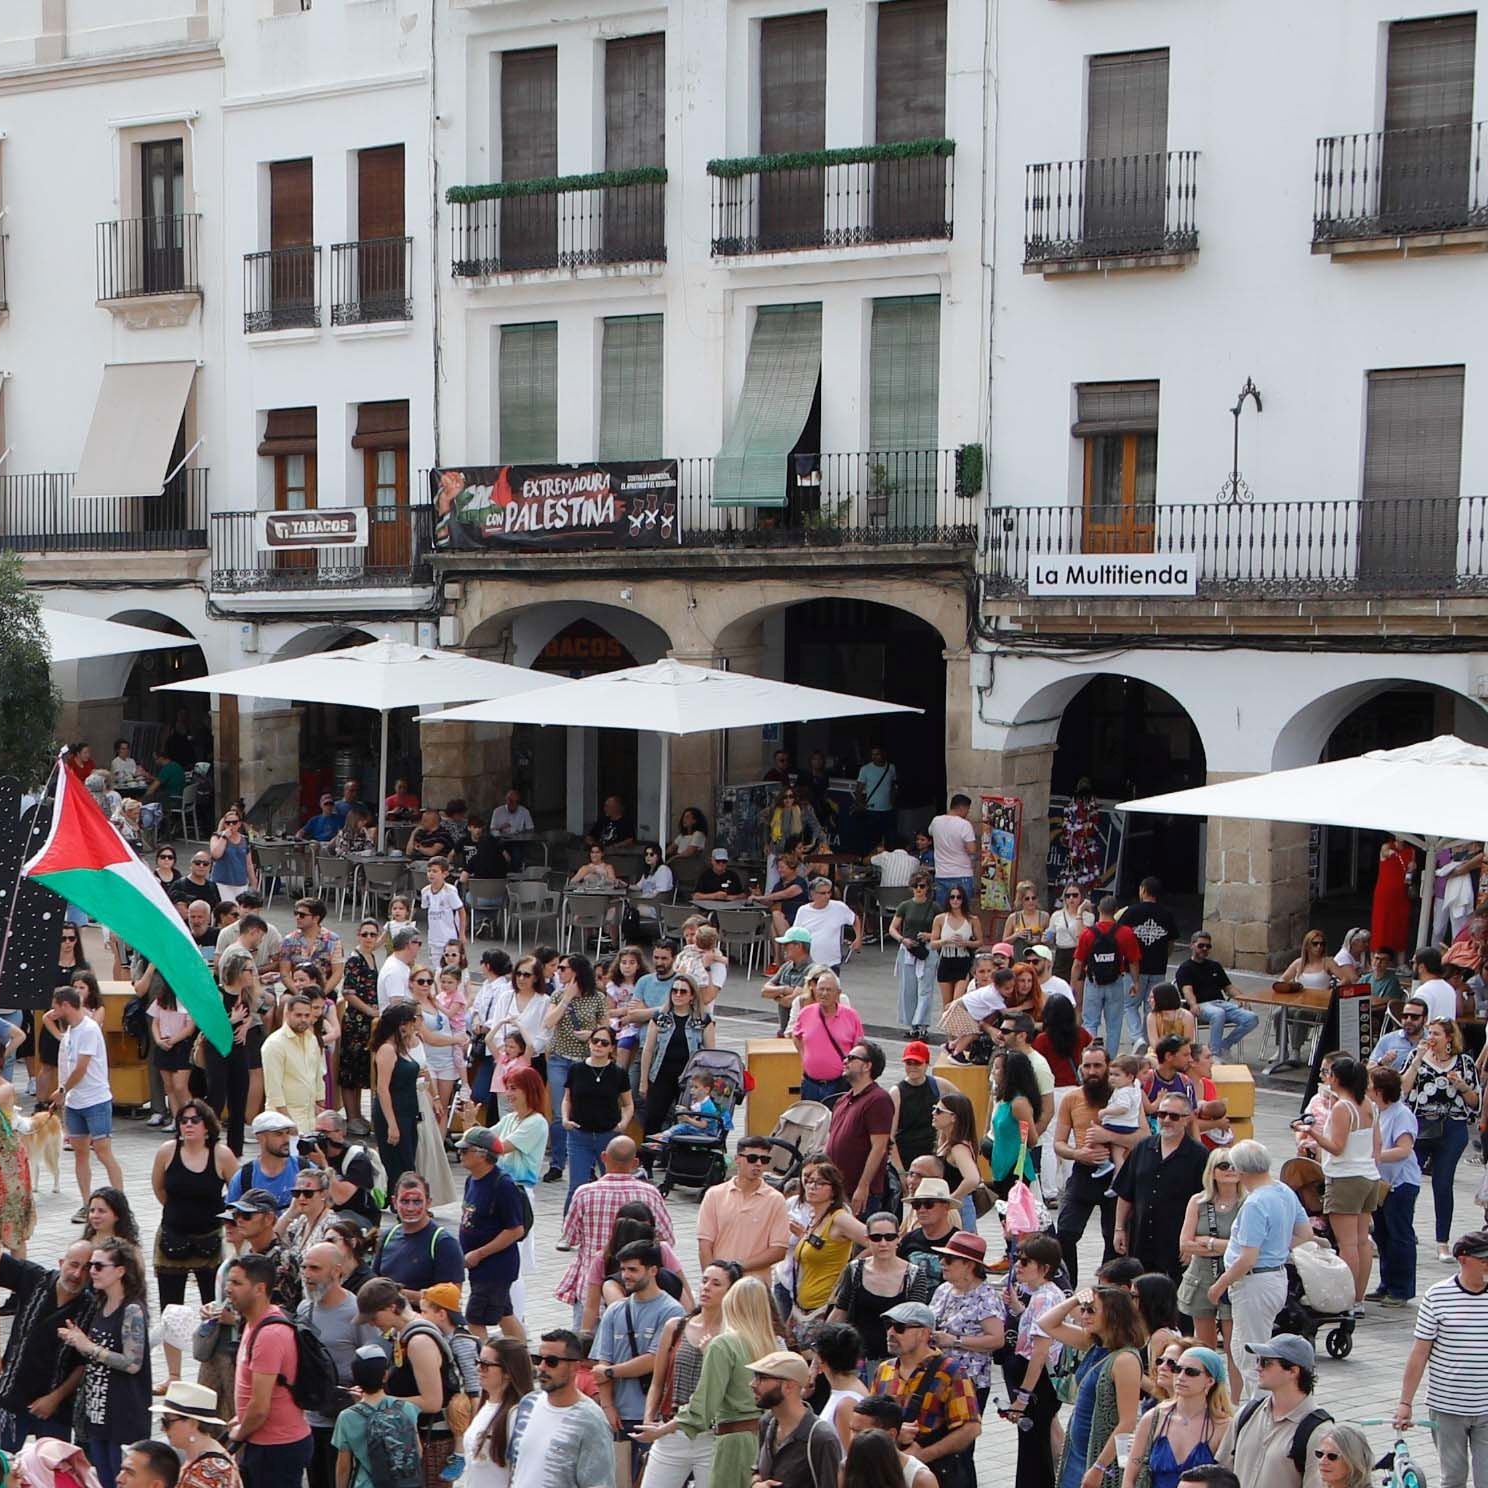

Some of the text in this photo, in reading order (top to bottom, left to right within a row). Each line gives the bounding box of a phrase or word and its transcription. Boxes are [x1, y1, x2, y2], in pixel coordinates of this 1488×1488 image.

[523, 473, 611, 498] EXTREMADURA
[485, 495, 616, 534] CON PALESTINA
[291, 520, 350, 534] TABACOS
[1036, 565, 1188, 585] La Multitienda
[1094, 952, 1115, 963] VANS
